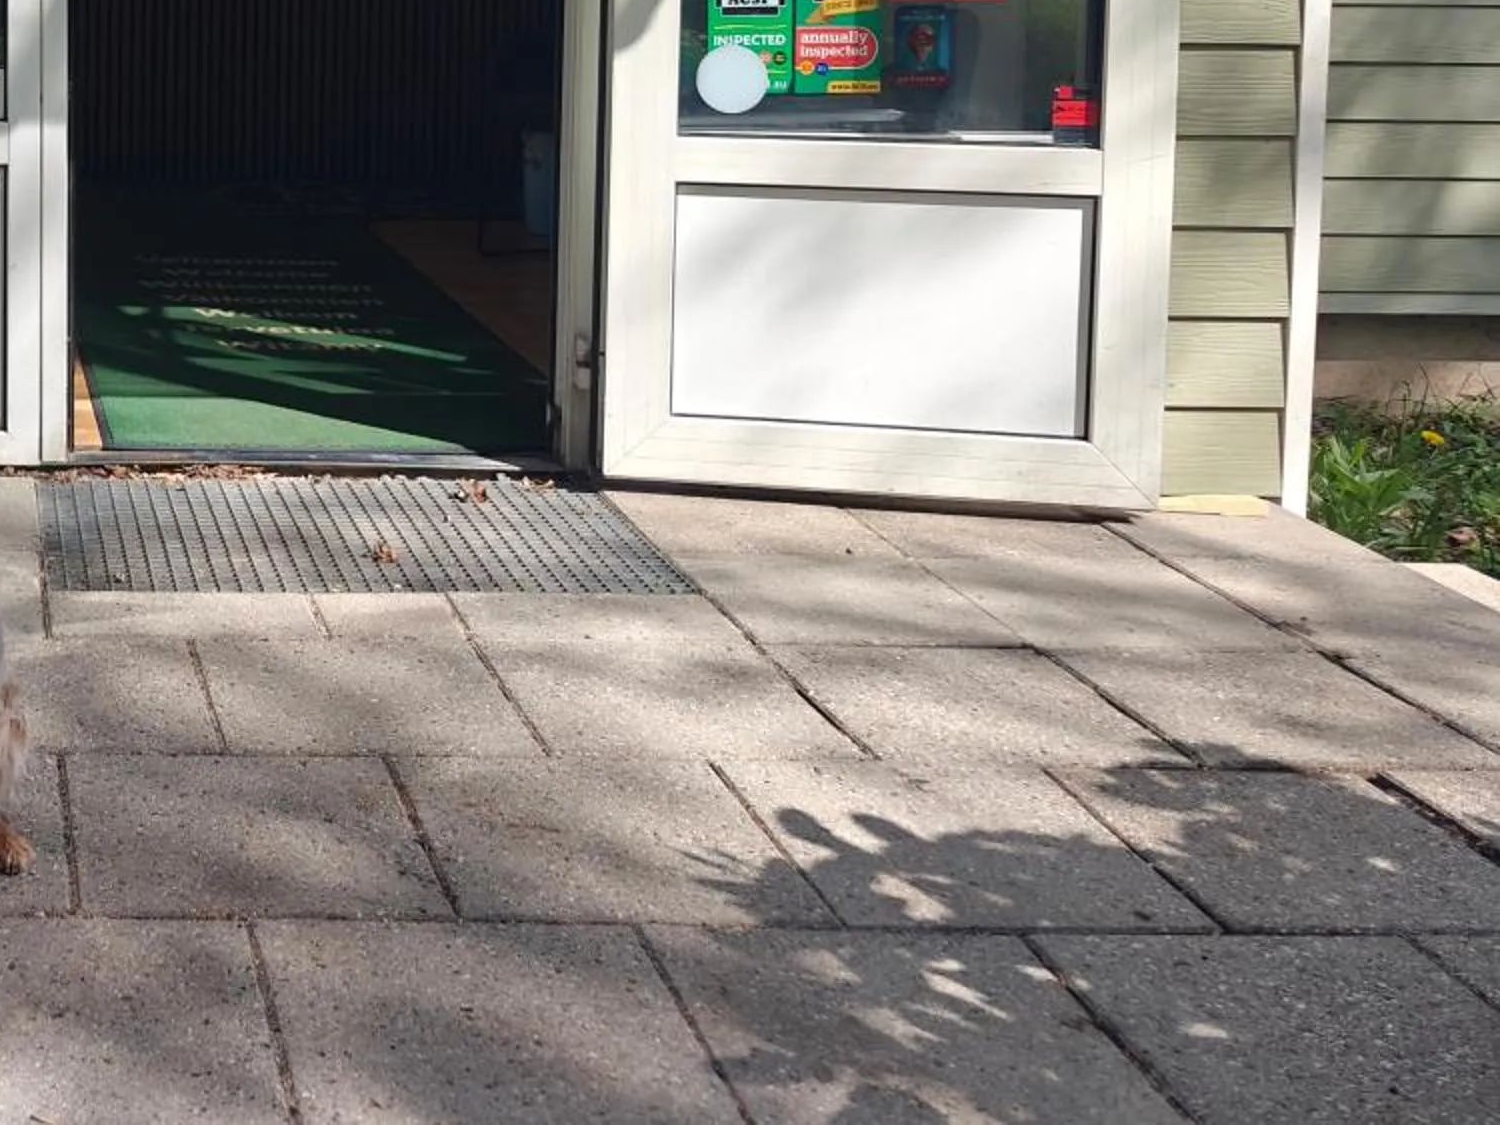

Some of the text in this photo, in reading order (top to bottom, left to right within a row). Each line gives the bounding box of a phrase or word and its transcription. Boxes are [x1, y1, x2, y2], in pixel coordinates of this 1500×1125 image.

[713, 34, 787, 46] INSPECTED
[800, 30, 868, 45] annually
[801, 44, 868, 60] inspected
